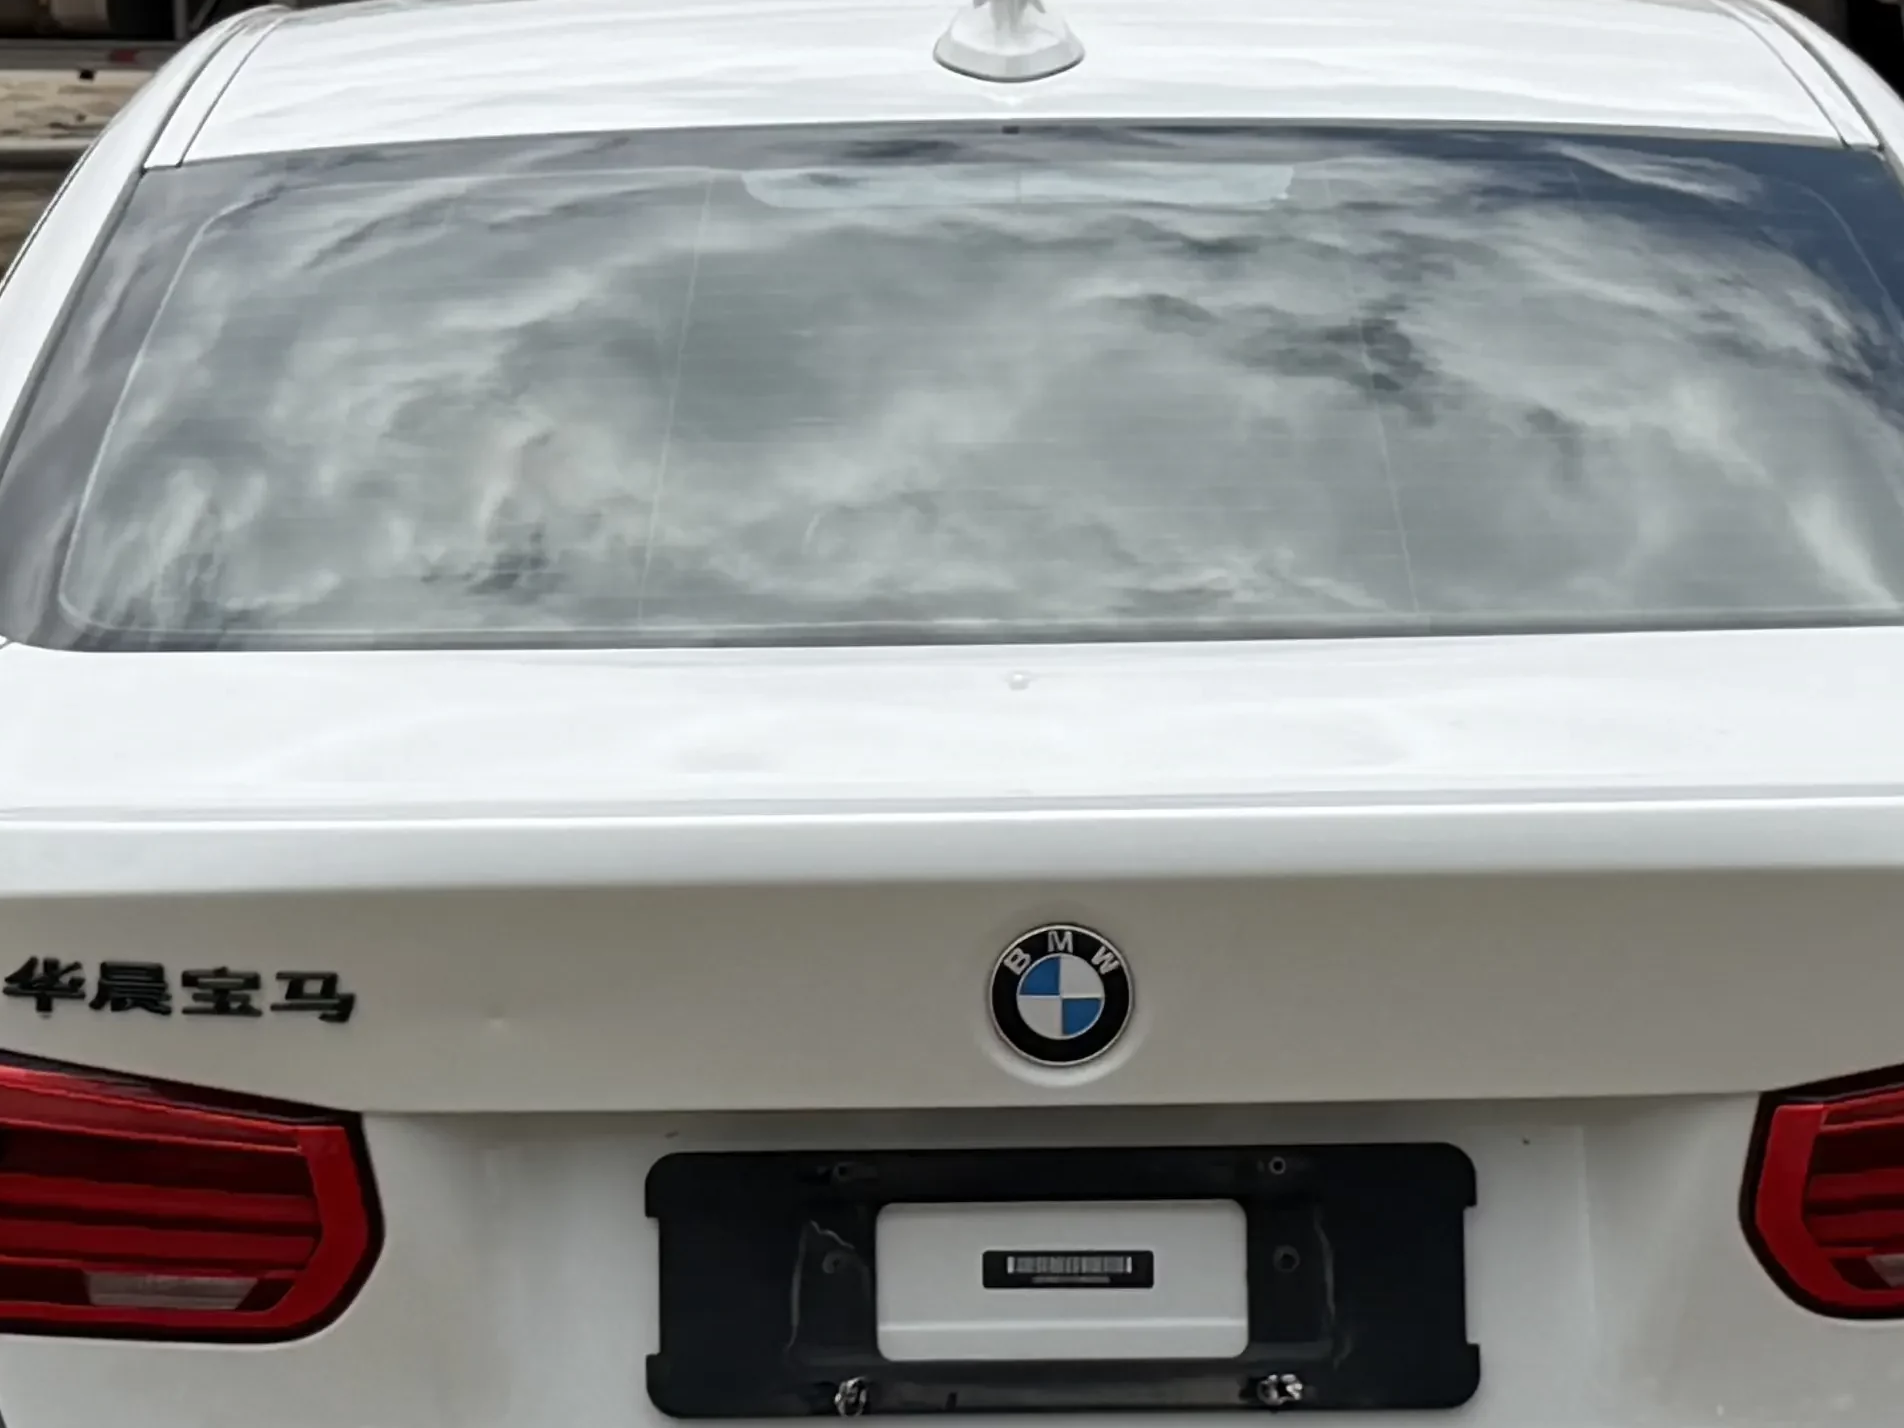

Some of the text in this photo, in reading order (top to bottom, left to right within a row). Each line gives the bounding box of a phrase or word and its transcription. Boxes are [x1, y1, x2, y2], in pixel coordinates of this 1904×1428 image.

[1003, 930, 1120, 975] BMW
[2, 955, 356, 1024] 华晨宝马
